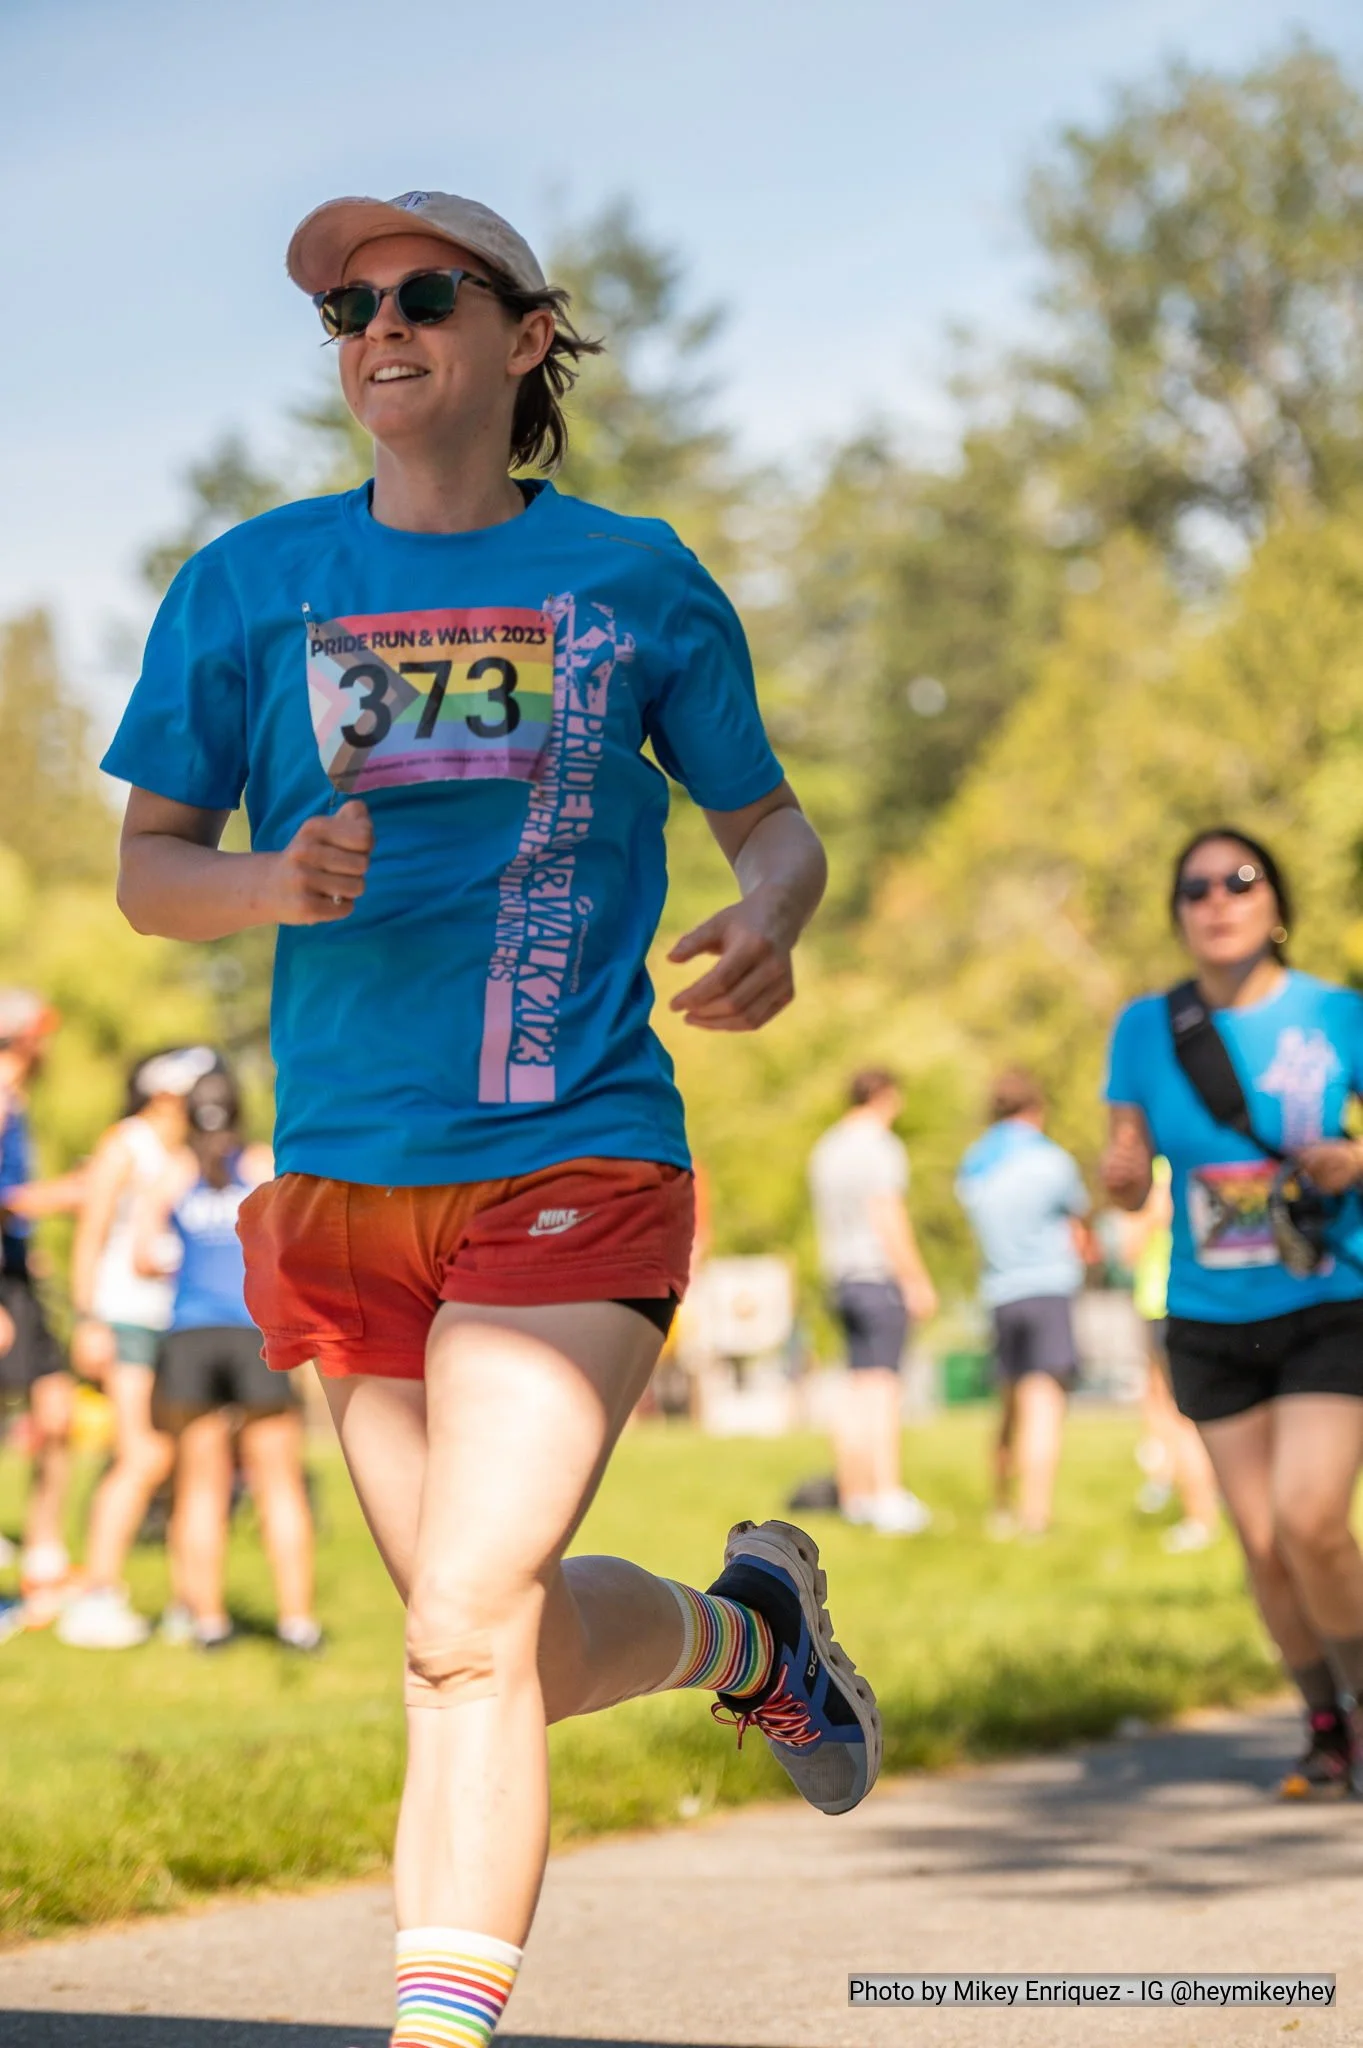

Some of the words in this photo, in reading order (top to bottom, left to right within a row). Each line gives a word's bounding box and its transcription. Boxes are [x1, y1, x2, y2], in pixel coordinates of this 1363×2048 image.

[311, 633, 368, 657] PRIDE
[372, 629, 416, 649] RUN
[418, 627, 433, 647] &
[437, 624, 496, 646] WALK
[501, 624, 547, 645] 2023
[338, 656, 521, 749] 373
[559, 713, 604, 808] PRIDE
[517, 896, 573, 982] WALK
[510, 988, 560, 1067] 2023
